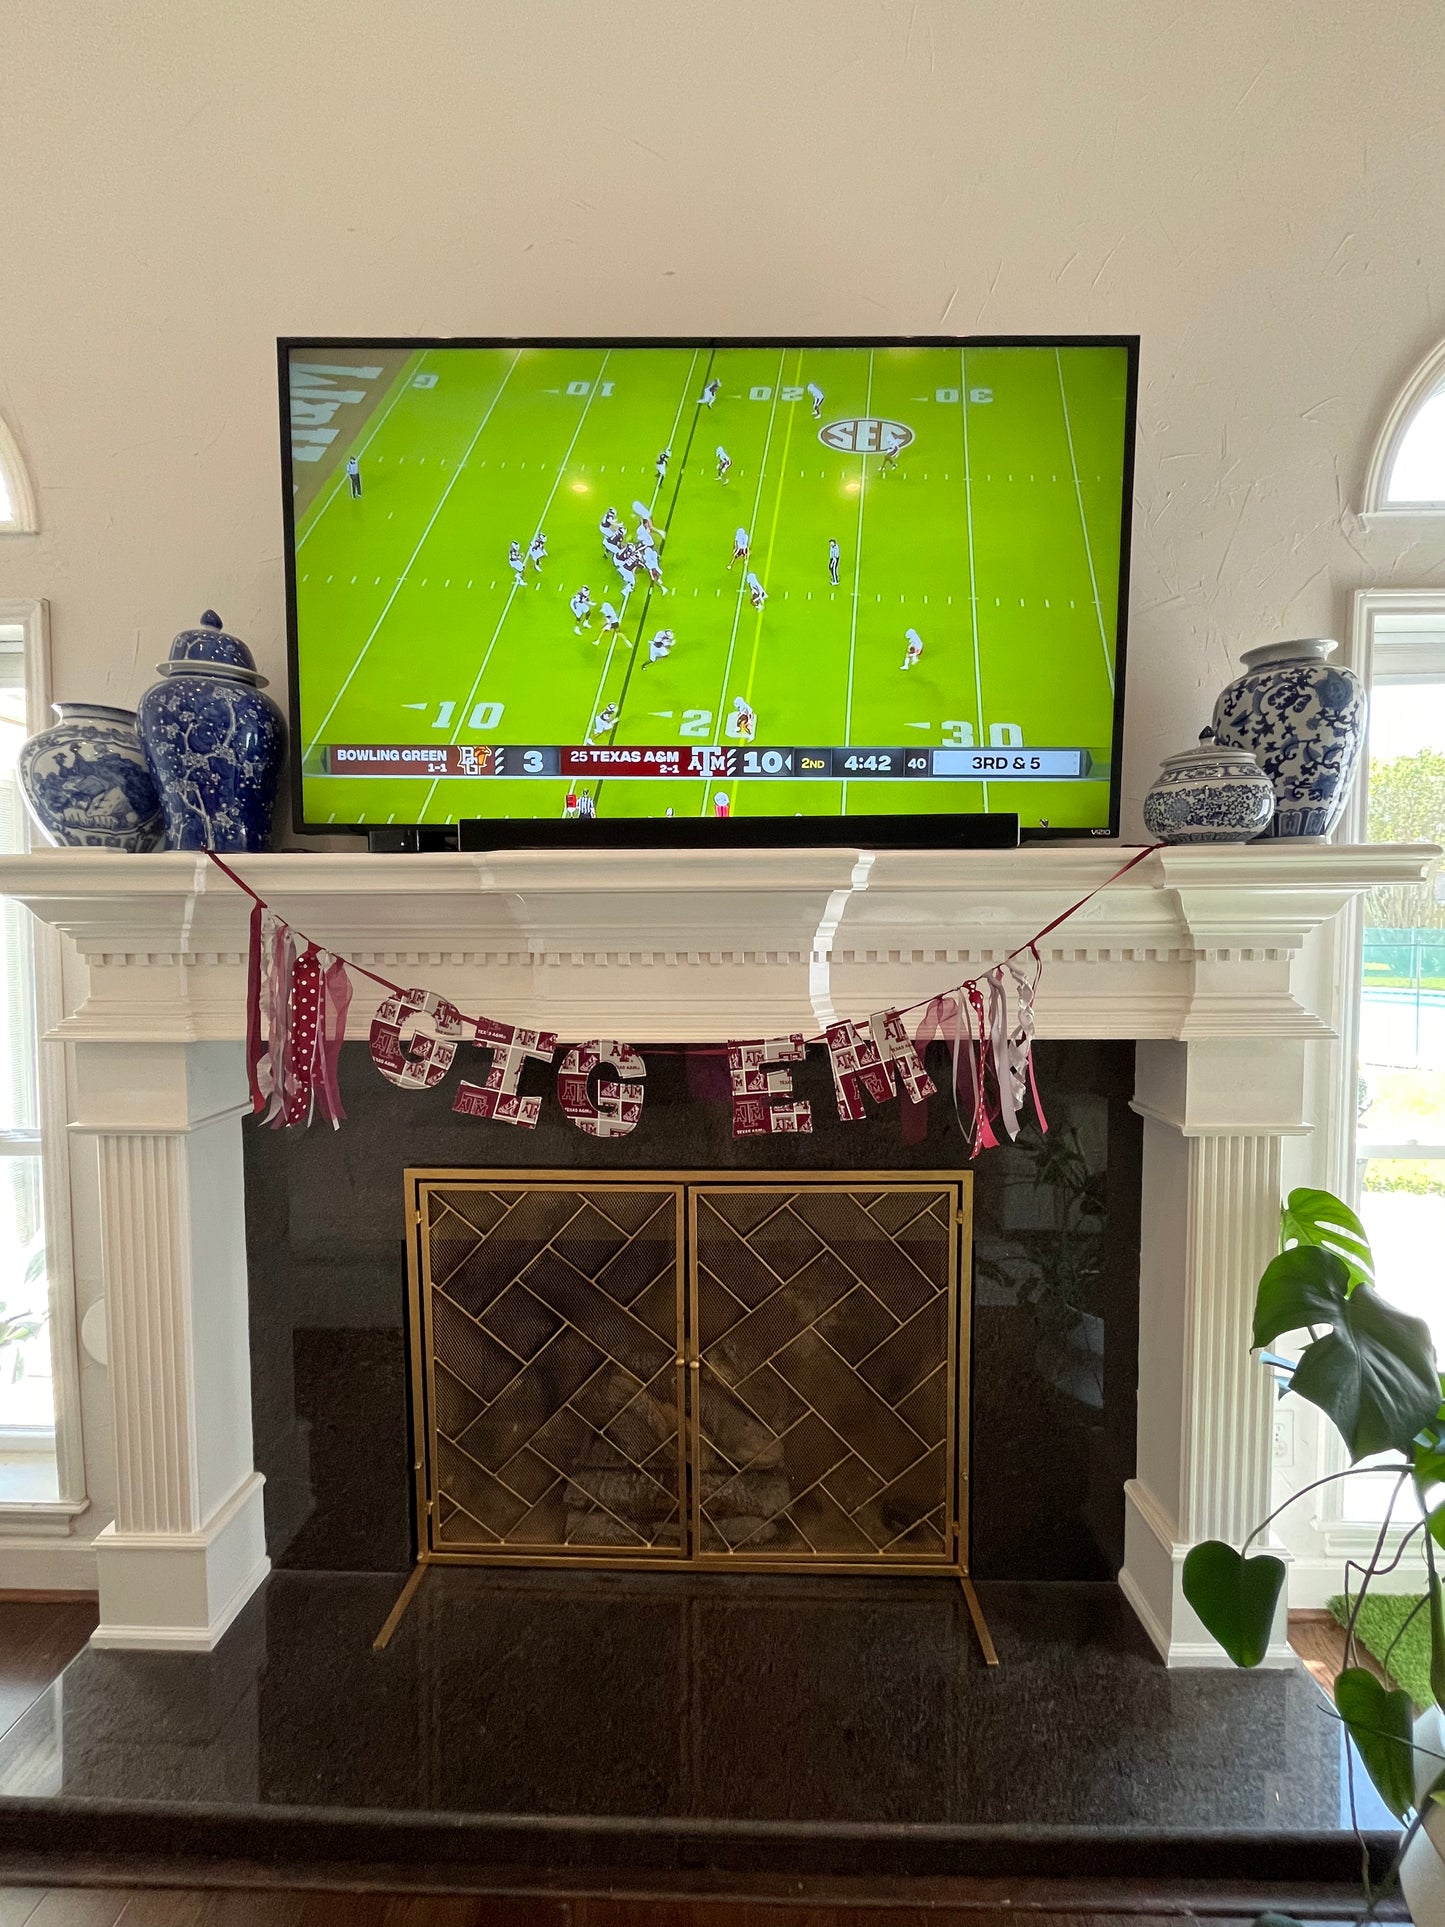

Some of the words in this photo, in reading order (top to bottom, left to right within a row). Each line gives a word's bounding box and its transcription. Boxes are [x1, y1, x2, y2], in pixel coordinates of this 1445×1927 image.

[431, 701, 506, 730] 10
[941, 720, 1025, 748] 30
[337, 749, 400, 762] BOWLING
[401, 750, 448, 762] GREEN
[522, 750, 545, 774] 3
[570, 751, 588, 763] 25
[589, 750, 642, 763] TEXAS
[643, 750, 680, 763] A&M
[427, 763, 448, 773] 1-1
[659, 764, 680, 774] 2-1
[743, 751, 783, 774] 10
[801, 757, 825, 770] 2ND
[844, 755, 892, 772] 4:42
[907, 757, 927, 770] 40
[972, 757, 1008, 770] 3RD
[1012, 757, 1027, 770] &
[1030, 757, 1041, 770] 5
[1090, 828, 1112, 836] VIZIO
